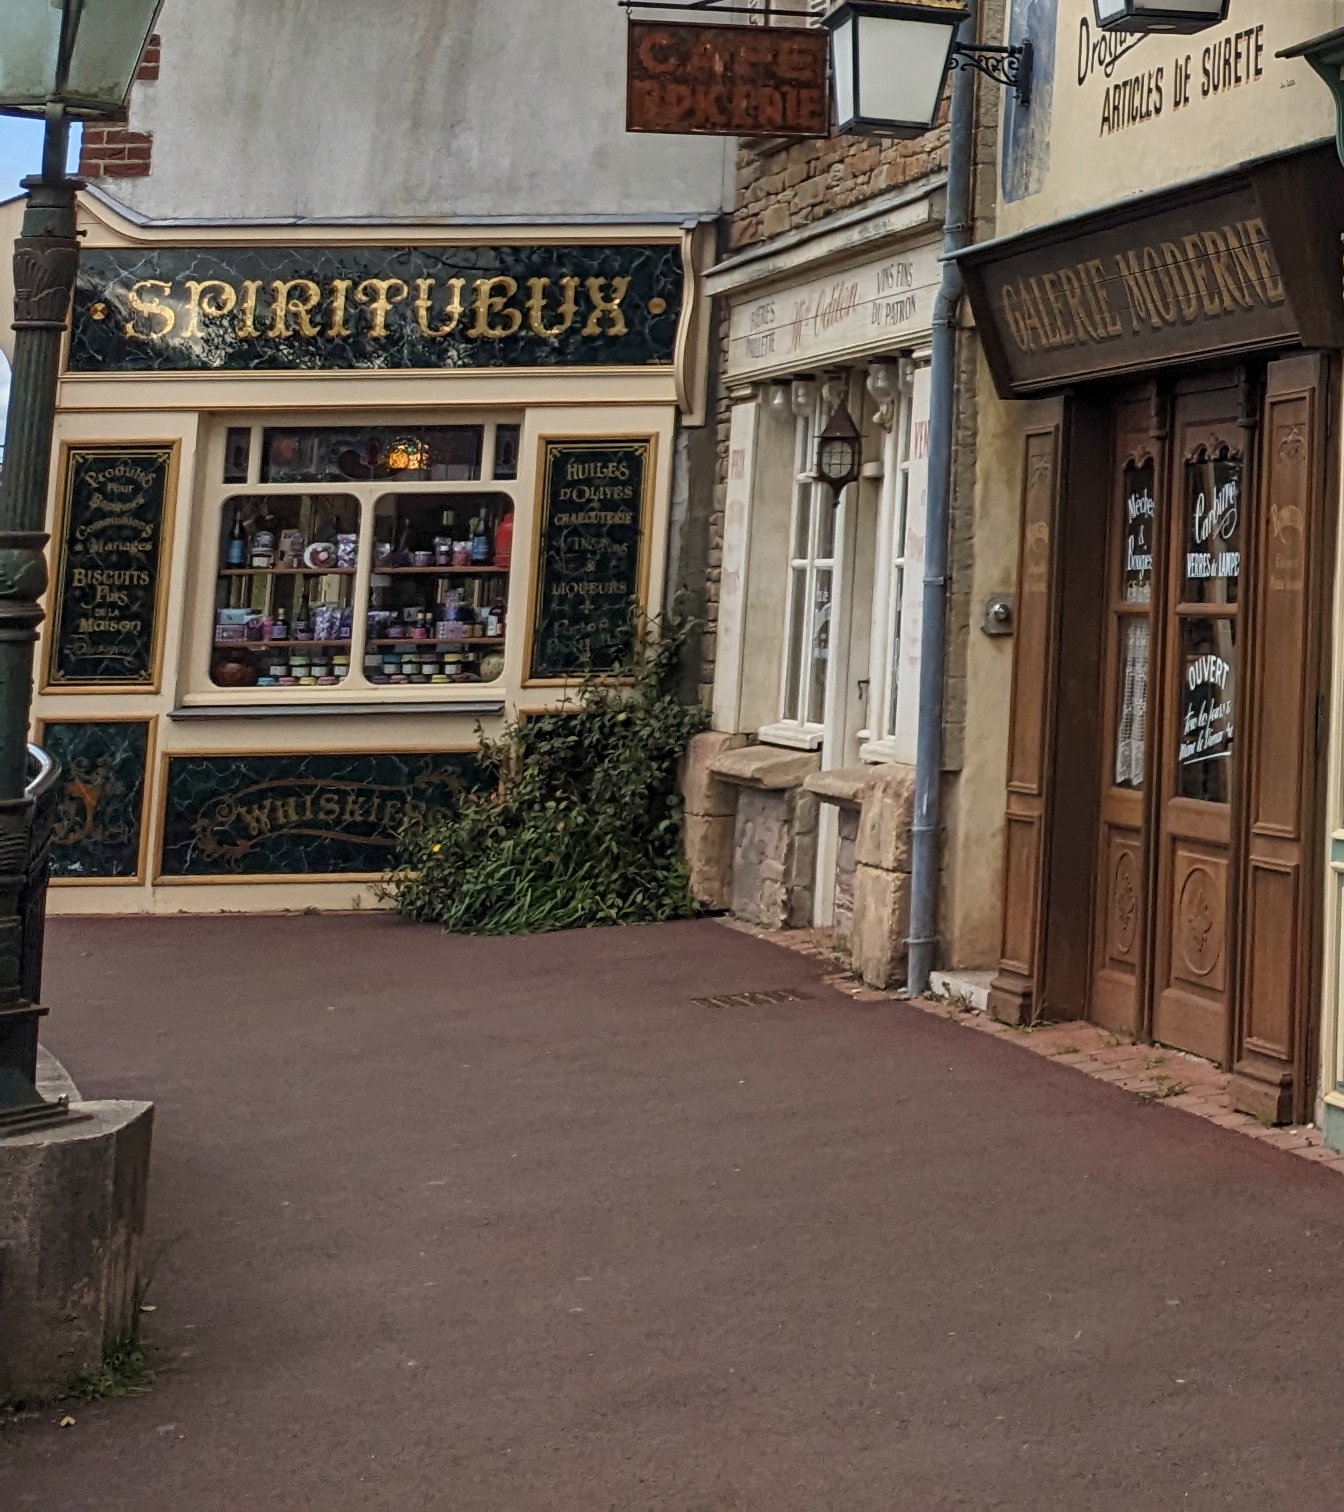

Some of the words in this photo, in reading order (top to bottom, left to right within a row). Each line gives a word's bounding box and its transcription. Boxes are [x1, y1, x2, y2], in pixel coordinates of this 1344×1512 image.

[1099, 66, 1165, 139] ARTICLES
[1172, 54, 1192, 112] DE
[1201, 24, 1265, 99] SURETE
[876, 263, 895, 294] VINS
[1001, 258, 1123, 354] GALERIE
[1114, 217, 1286, 336] MODERNE
[124, 276, 632, 340] SPIRITUEUX
[871, 301, 883, 326] DU
[885, 293, 917, 326] PATRON
[567, 462, 629, 480] HUILES
[72, 568, 150, 587] BISCUITS
[1187, 552, 1211, 578] VERRES
[1189, 654, 1230, 690] OUVERT
